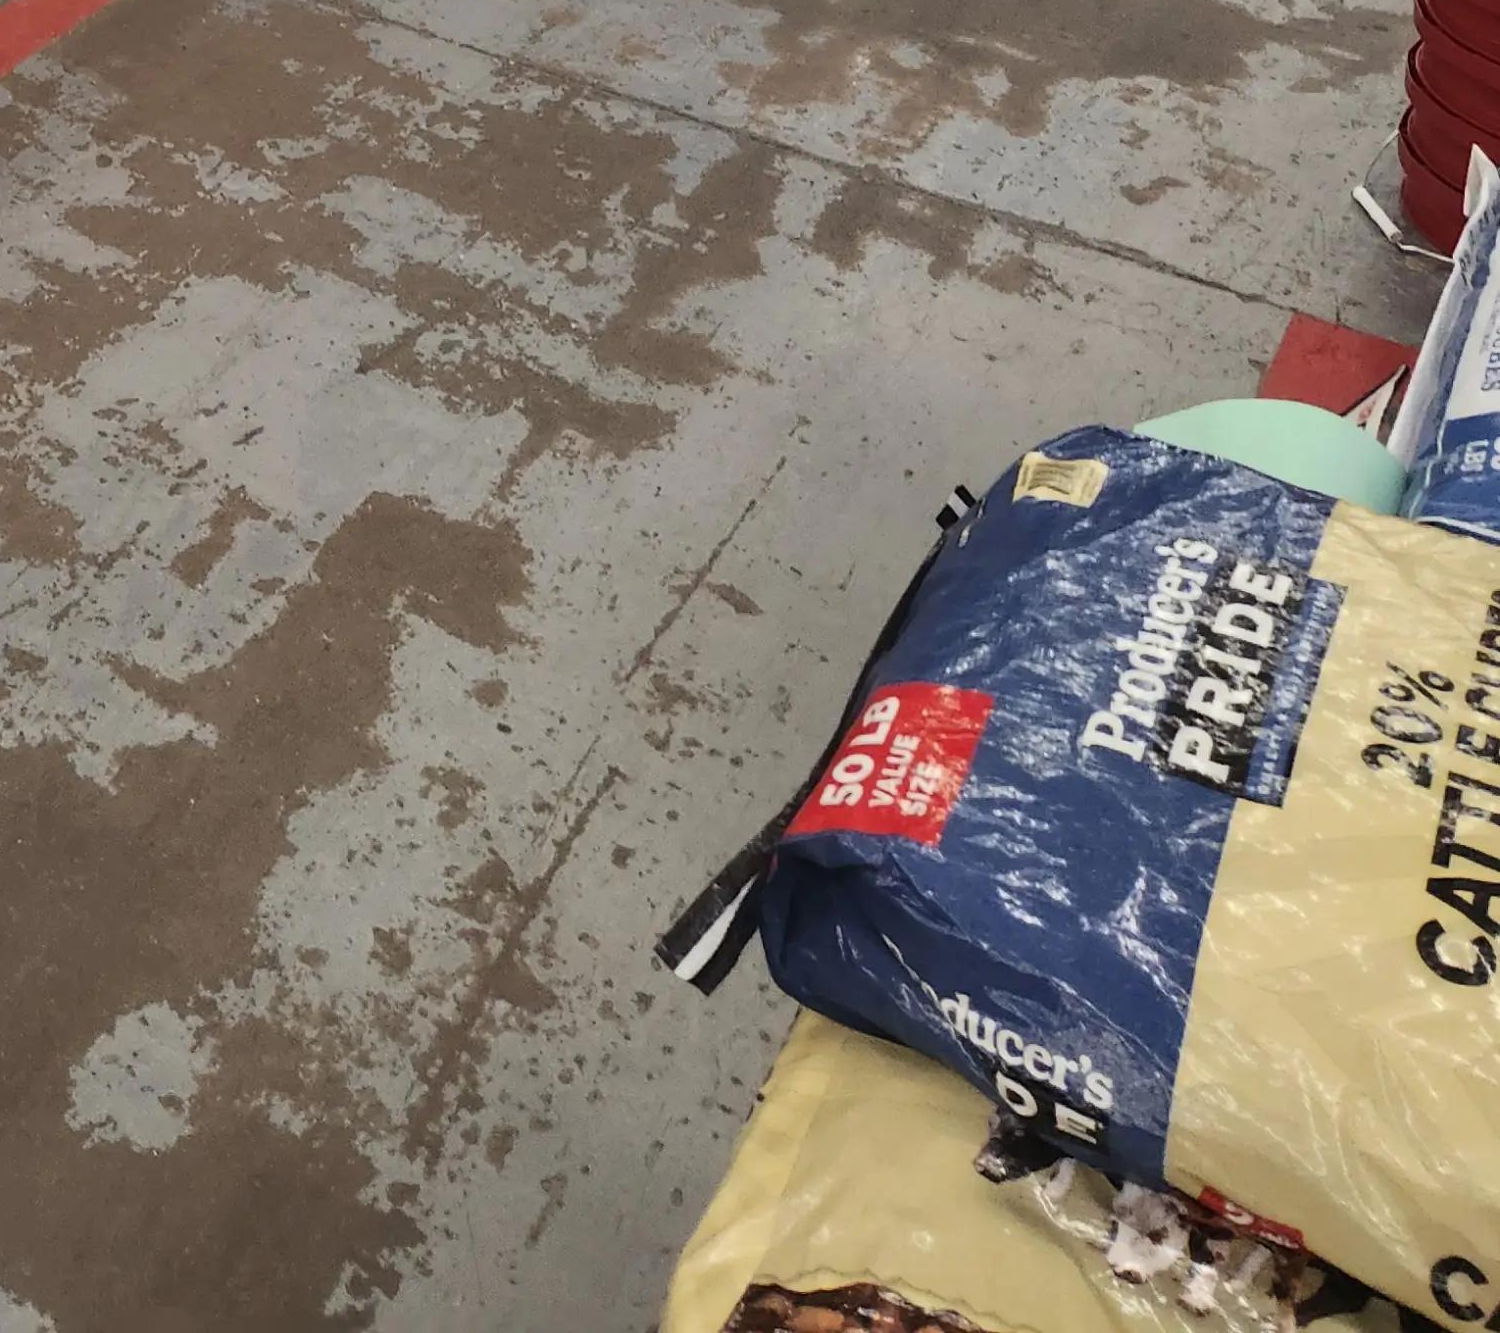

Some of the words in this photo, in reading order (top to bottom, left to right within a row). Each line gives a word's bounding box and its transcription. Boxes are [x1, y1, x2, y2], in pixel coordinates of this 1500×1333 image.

[1078, 535, 1219, 763] Producer's
[1168, 562, 1293, 784] PRIDE
[820, 751, 875, 808] 50
[848, 695, 901, 749] LB
[869, 733, 922, 810] VALUE
[1361, 660, 1456, 790] 20%
[899, 760, 945, 818] SIZE
